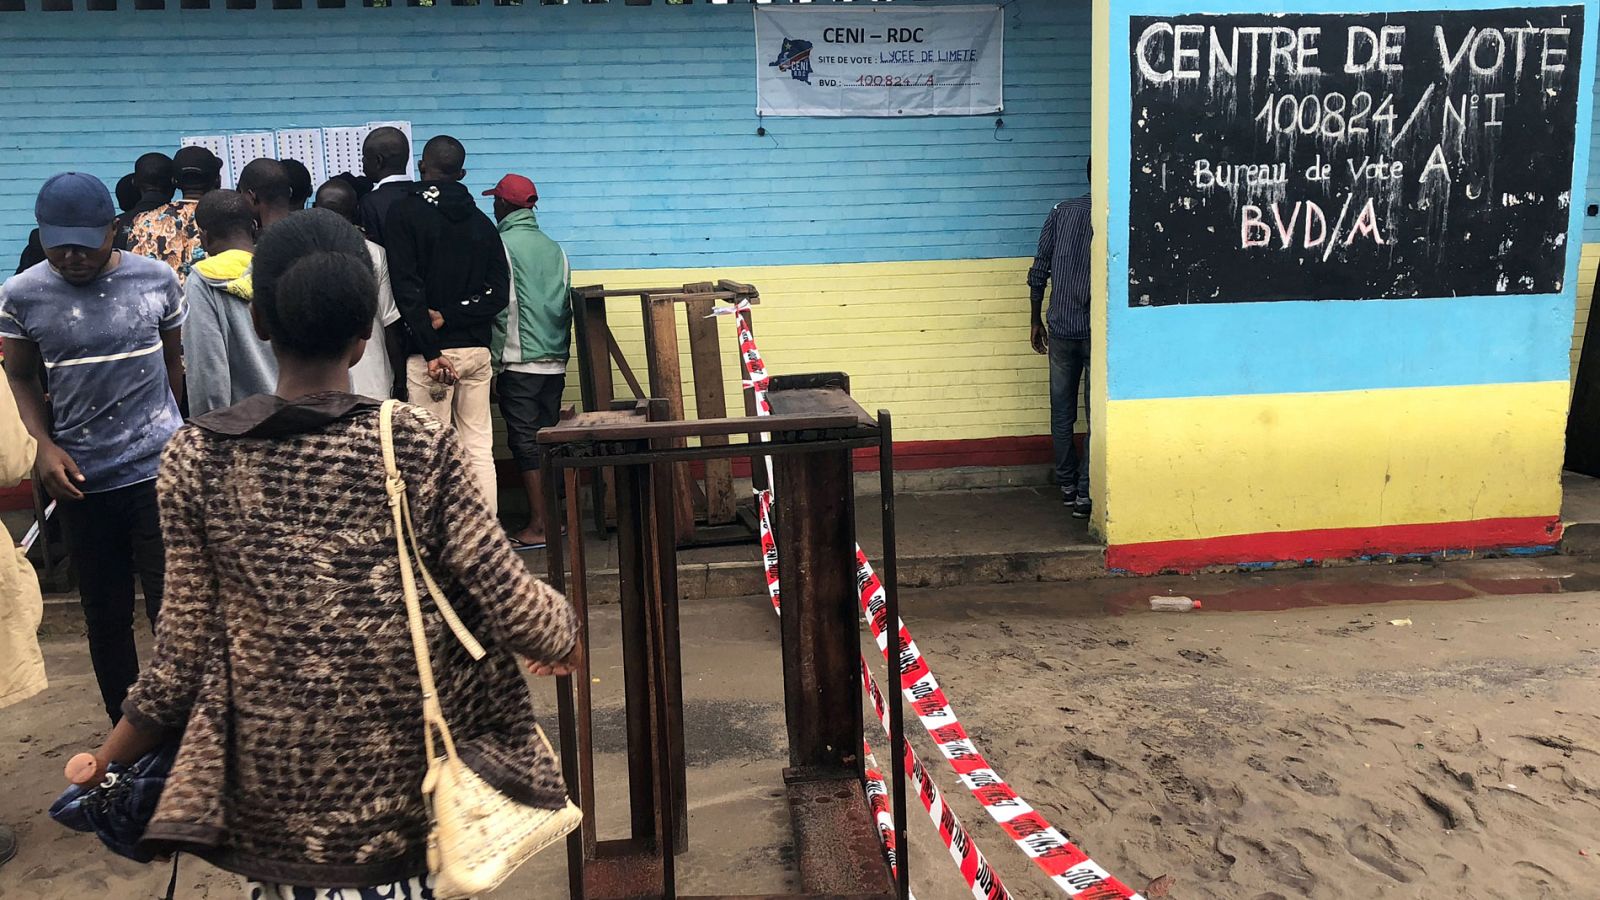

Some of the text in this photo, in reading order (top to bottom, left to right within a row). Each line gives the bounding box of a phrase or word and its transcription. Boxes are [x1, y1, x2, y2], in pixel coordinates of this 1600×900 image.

[823, 27, 865, 44] CENI
[887, 27, 924, 43] RDC
[1135, 22, 1571, 82] CENTRE DE VOTE
[791, 61, 809, 71] CENI
[818, 55, 837, 64] SITE
[837, 56, 849, 64] DE
[850, 56, 873, 64] VOTE
[879, 50, 915, 63] LYCEE
[920, 50, 934, 62] DE
[937, 49, 977, 62] LIMETE
[819, 79, 838, 87] BVD
[1194, 143, 1452, 189] Bureau de Vote A
[909, 680, 948, 719] CENI-RDC
[934, 726, 978, 762] CENI-RDC
[968, 769, 1019, 808] CENI-RDC
[1008, 818, 1072, 858] CENI-RDC
